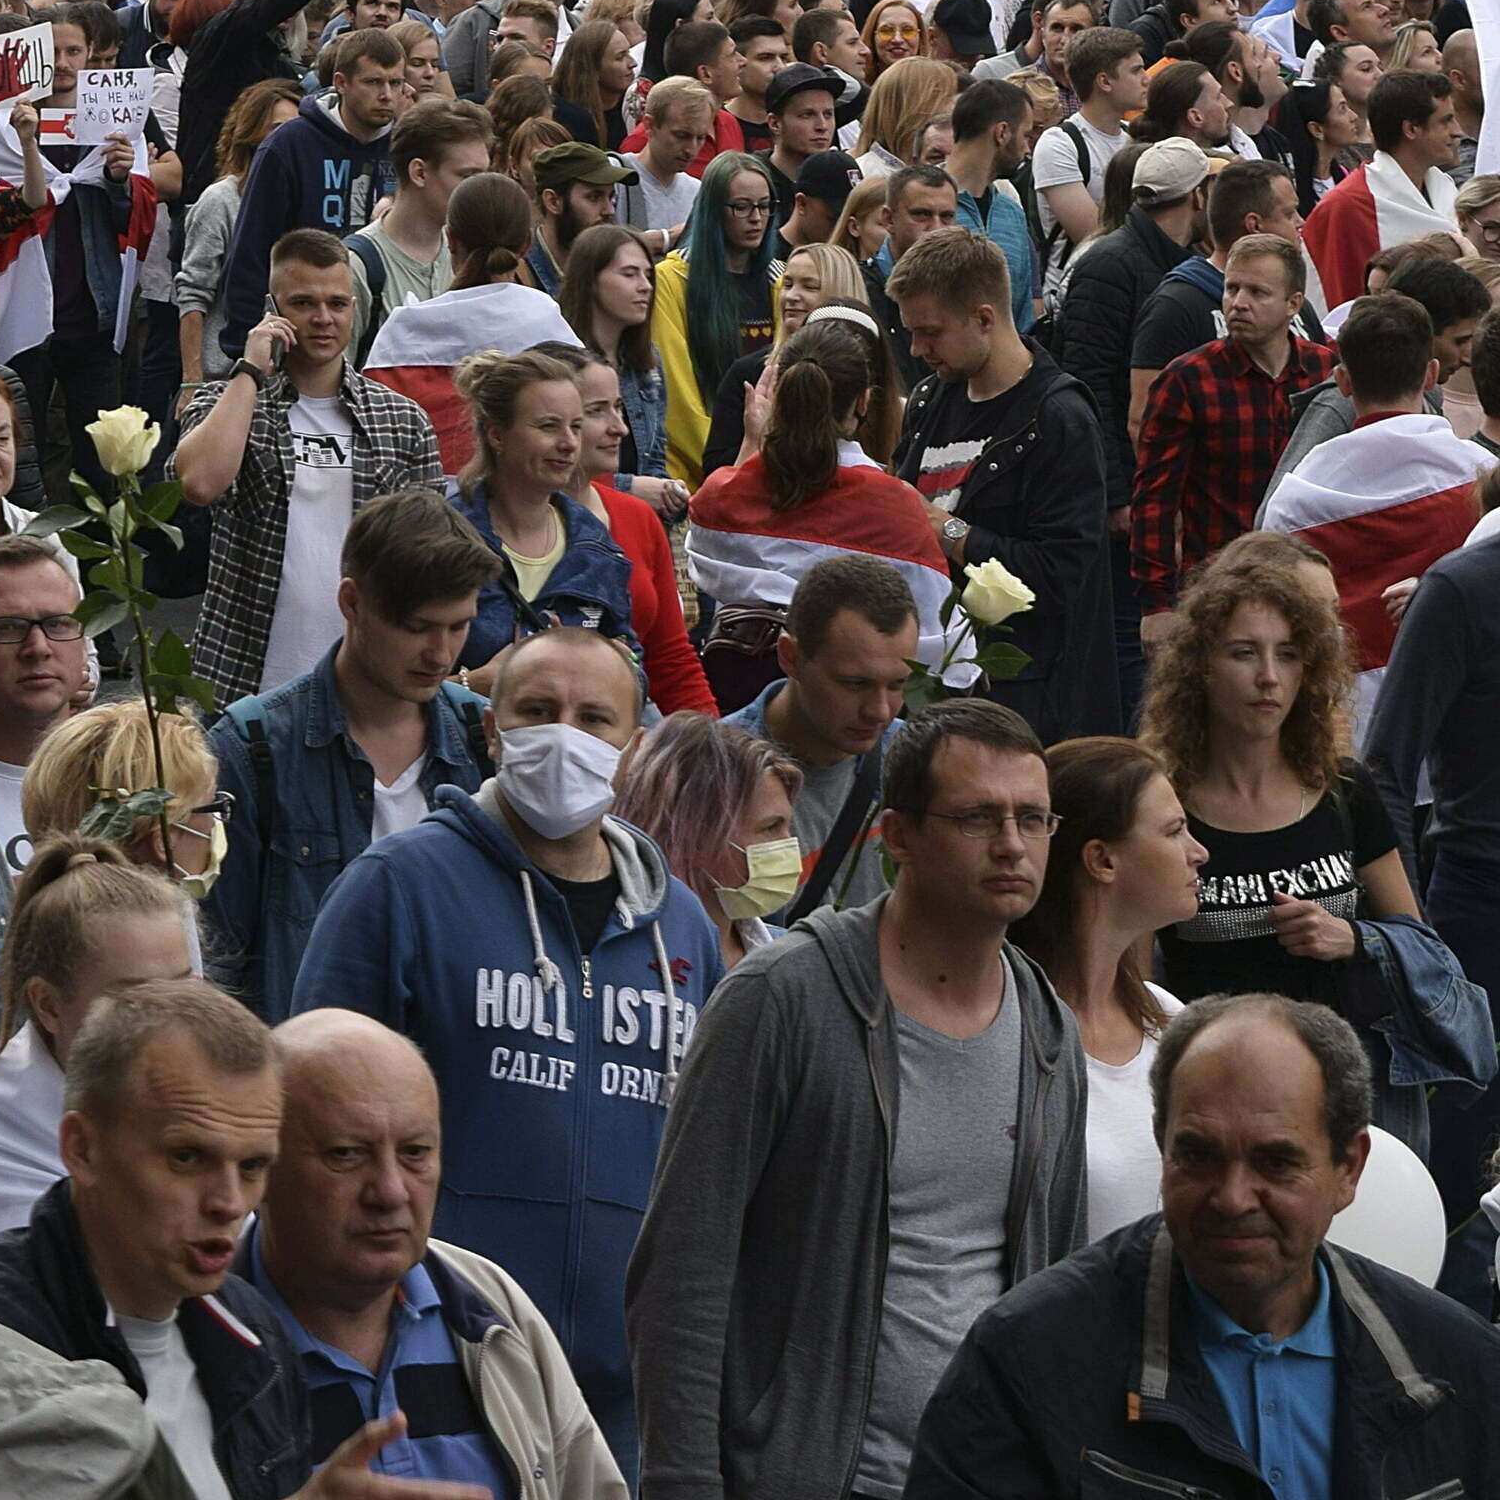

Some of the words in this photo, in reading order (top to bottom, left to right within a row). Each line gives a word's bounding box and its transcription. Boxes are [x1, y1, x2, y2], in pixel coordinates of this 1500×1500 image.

[87, 70, 138, 88] САНЯ,
[82, 92, 98, 104] ТЫ
[108, 92, 123, 103] НЕ
[1196, 874, 1268, 904] MANI
